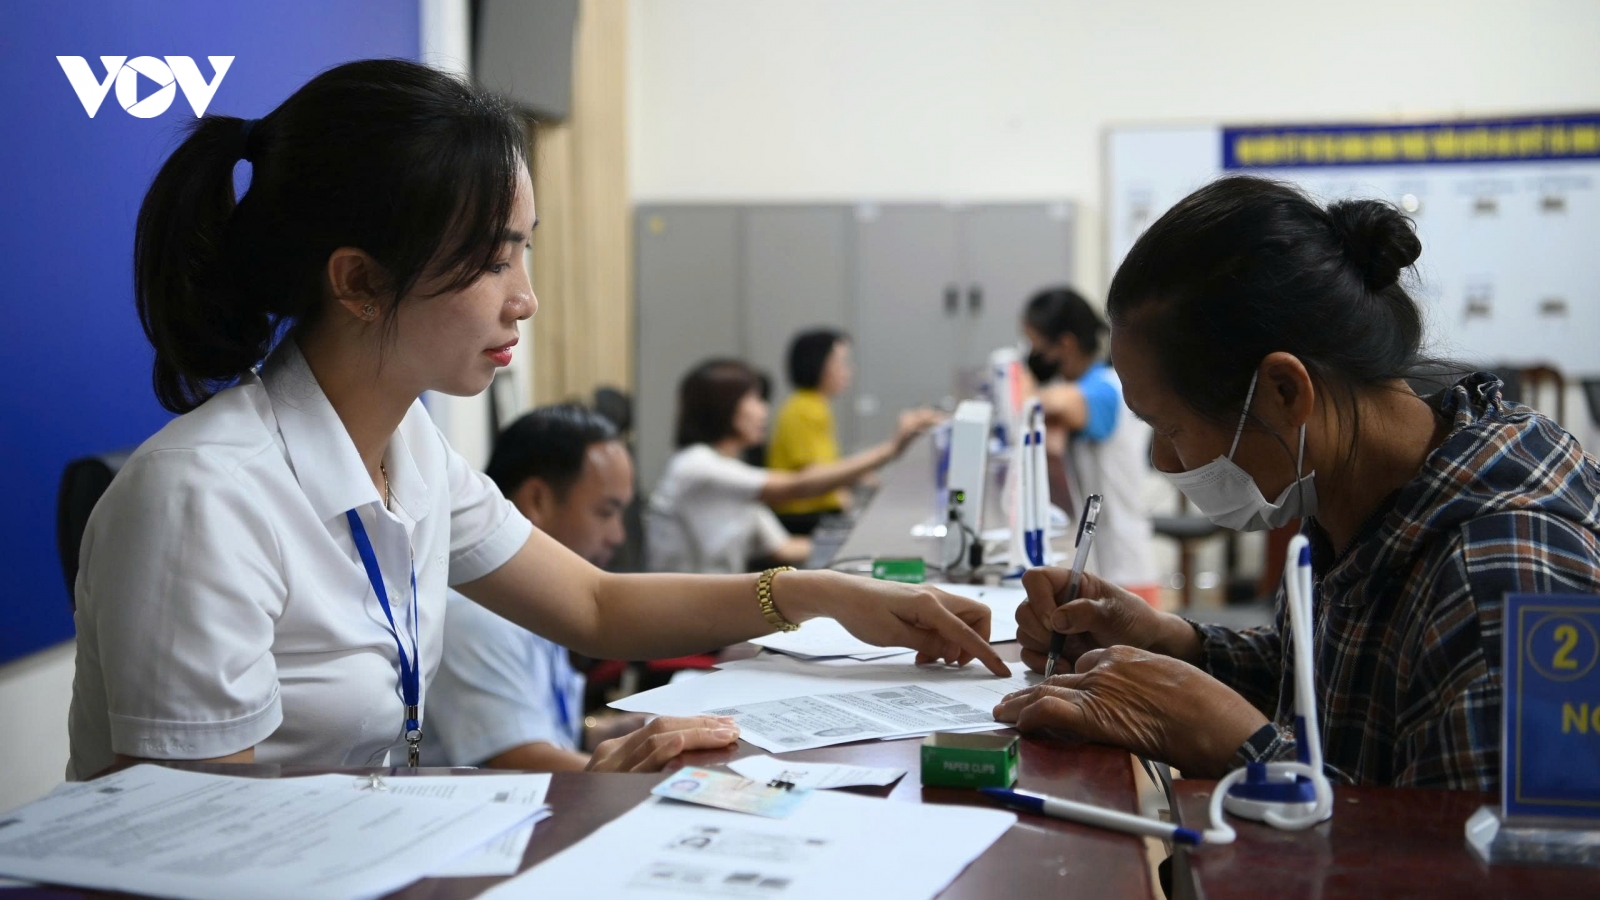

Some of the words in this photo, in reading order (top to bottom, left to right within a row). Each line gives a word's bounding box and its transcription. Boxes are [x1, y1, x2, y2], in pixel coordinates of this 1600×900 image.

[1553, 626, 1579, 669] 2
[943, 761, 970, 773] PAPER
[972, 763, 995, 774] CLIPS
